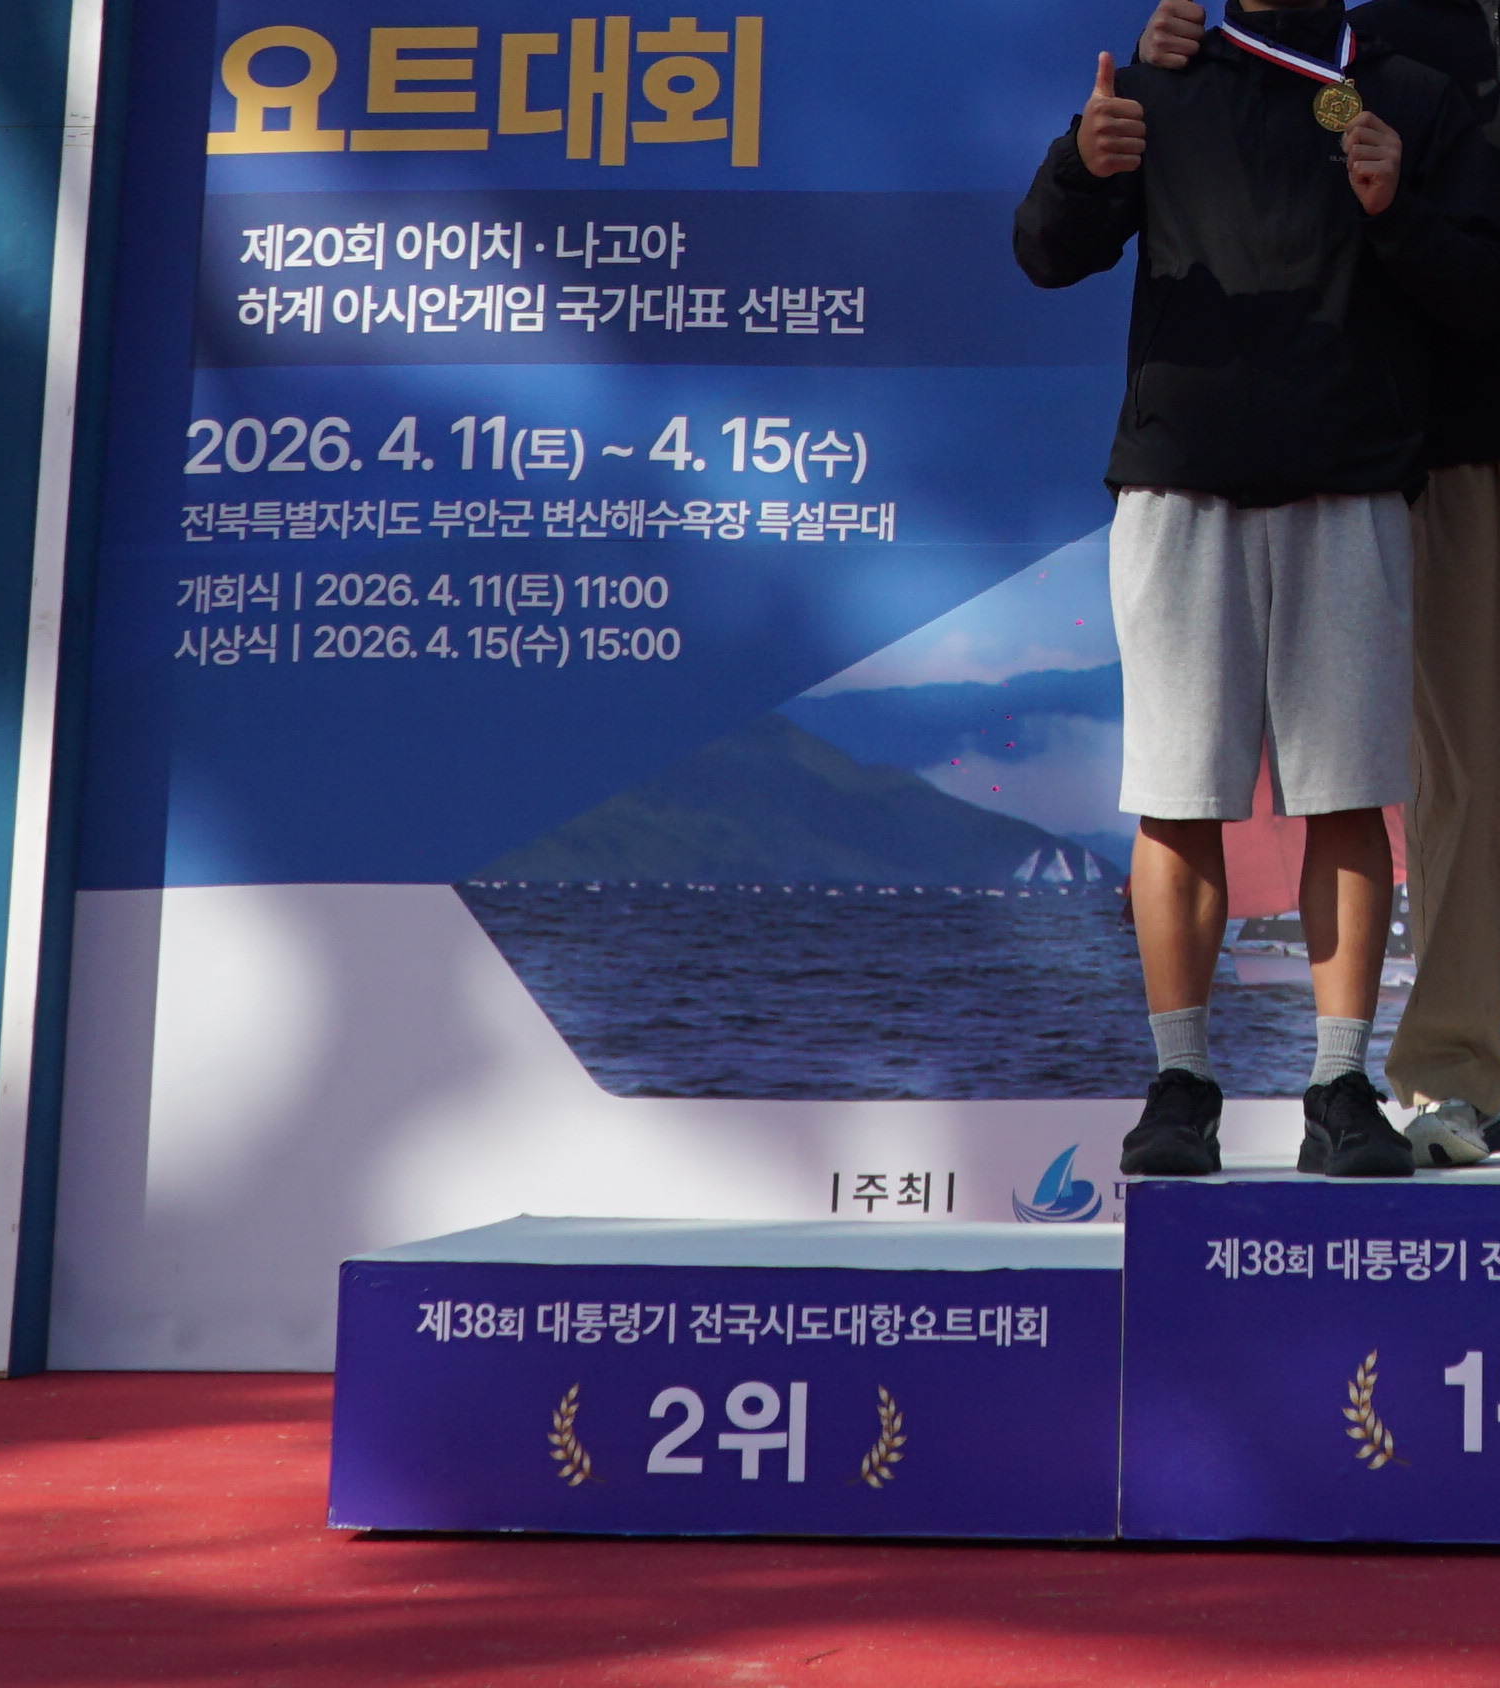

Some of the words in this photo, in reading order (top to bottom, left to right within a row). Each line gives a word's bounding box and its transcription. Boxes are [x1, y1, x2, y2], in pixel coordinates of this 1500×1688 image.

[206, 15, 763, 166] 요트대회
[241, 223, 384, 271] 제20회
[396, 222, 521, 269] 아이치
[556, 222, 685, 265] 나고야
[239, 286, 323, 334] 하계
[333, 285, 544, 333] 아시안게임
[556, 285, 728, 332] 국가대표
[739, 286, 864, 334] 선발전
[184, 417, 362, 474] 2026.
[378, 416, 433, 470] 4.
[451, 416, 584, 480] 11(토)
[650, 416, 706, 471] 4.
[722, 417, 866, 483] 15(수)
[182, 500, 421, 541] 전북특별자치도
[429, 499, 534, 538] 부안군
[543, 499, 751, 540] 변산해수욕장
[756, 501, 894, 541] 특설무대
[177, 572, 279, 613] 개회식
[316, 573, 419, 606] 2026.
[428, 574, 460, 606] 4.
[470, 574, 564, 613] 11(토)
[575, 576, 668, 608] 11:00
[175, 624, 277, 665] 시상식
[314, 625, 417, 658] 2026.
[426, 626, 459, 658] 4.
[468, 625, 569, 667] 15(수)
[581, 627, 680, 660] 15:00
[1206, 1238, 1313, 1279] 제38회
[1327, 1239, 1466, 1281] 대통령기
[417, 1301, 524, 1341] 제38회
[537, 1302, 676, 1343] 대통령기
[690, 1303, 1047, 1347] 전국시도대항요트대회
[647, 1381, 807, 1482] 2위
